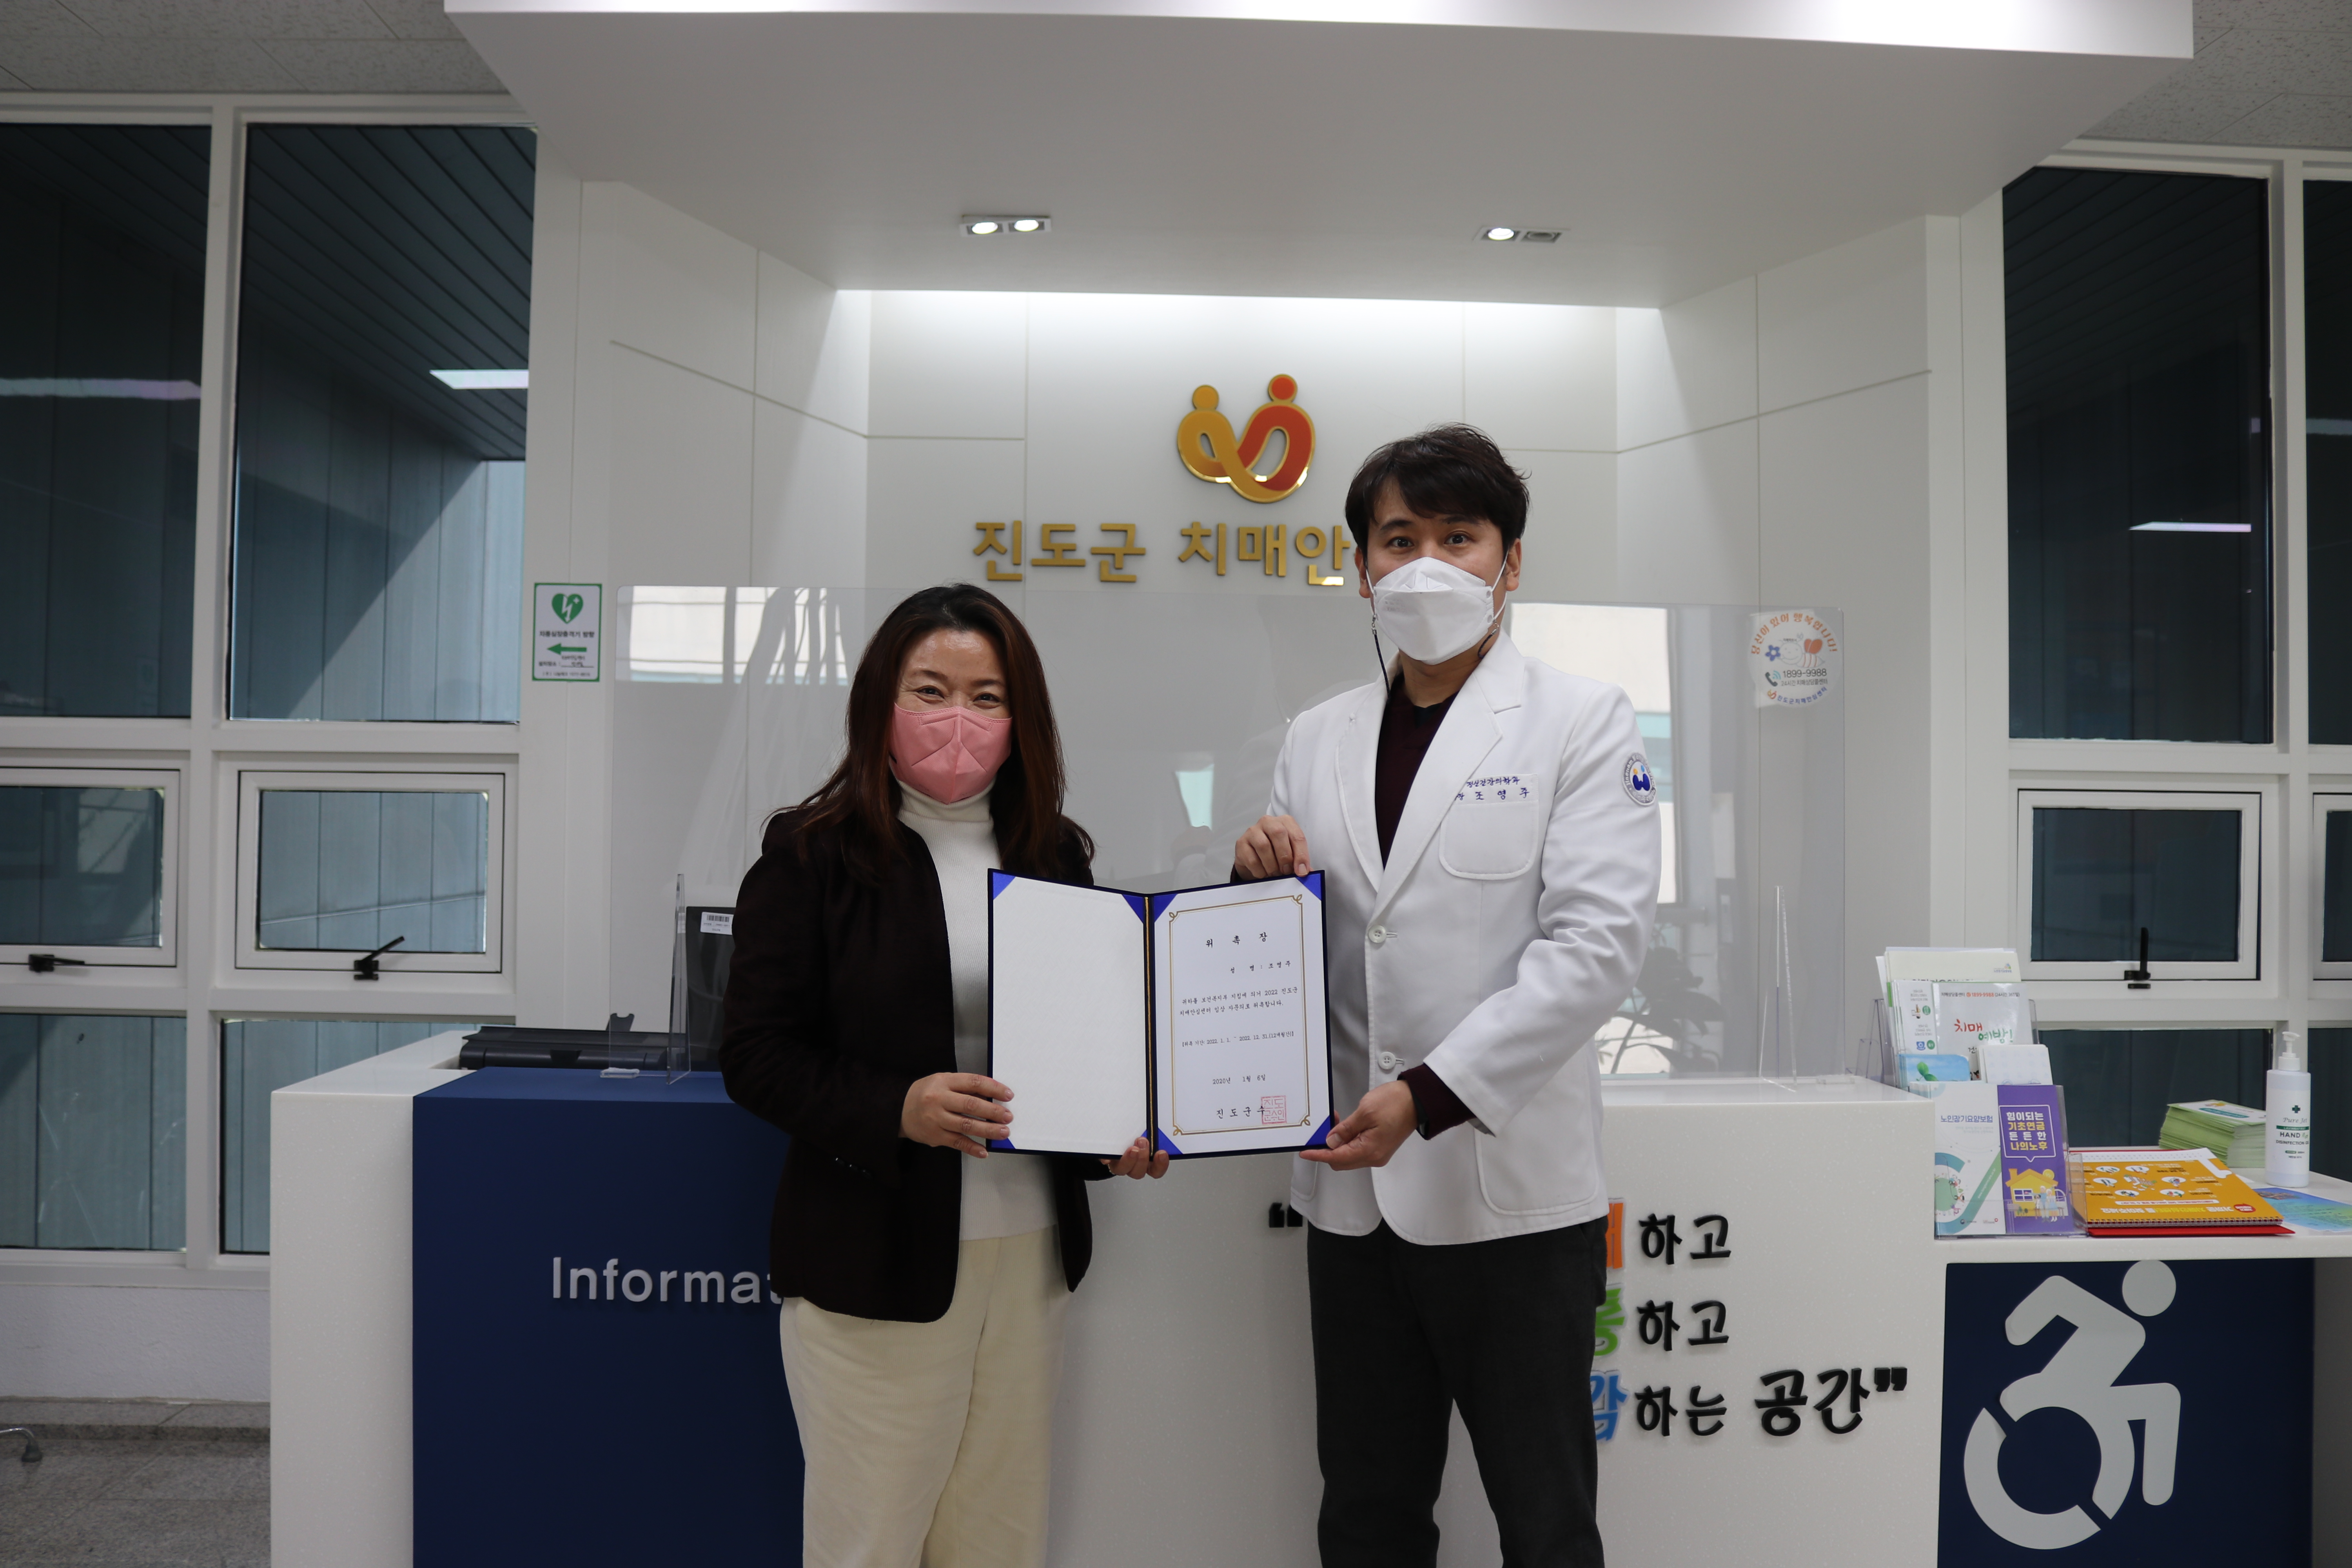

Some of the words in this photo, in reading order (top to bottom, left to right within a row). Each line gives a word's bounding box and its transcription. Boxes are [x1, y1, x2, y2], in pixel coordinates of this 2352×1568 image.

[973, 521, 1145, 582] 진도군
[1770, 613, 1789, 628] 있어
[1783, 668, 1827, 678] 1899-9988
[1466, 776, 1520, 788] 정신건강의학과
[1201, 995, 1227, 1003] 보건복지부
[1180, 1007, 1211, 1016] 치매안심센터
[1253, 1000, 1283, 1008] 위촉합니다.
[1955, 1019, 1983, 1032] 치매
[1978, 1029, 2013, 1044] 예방!
[2008, 1122, 2045, 1131] 기초연금
